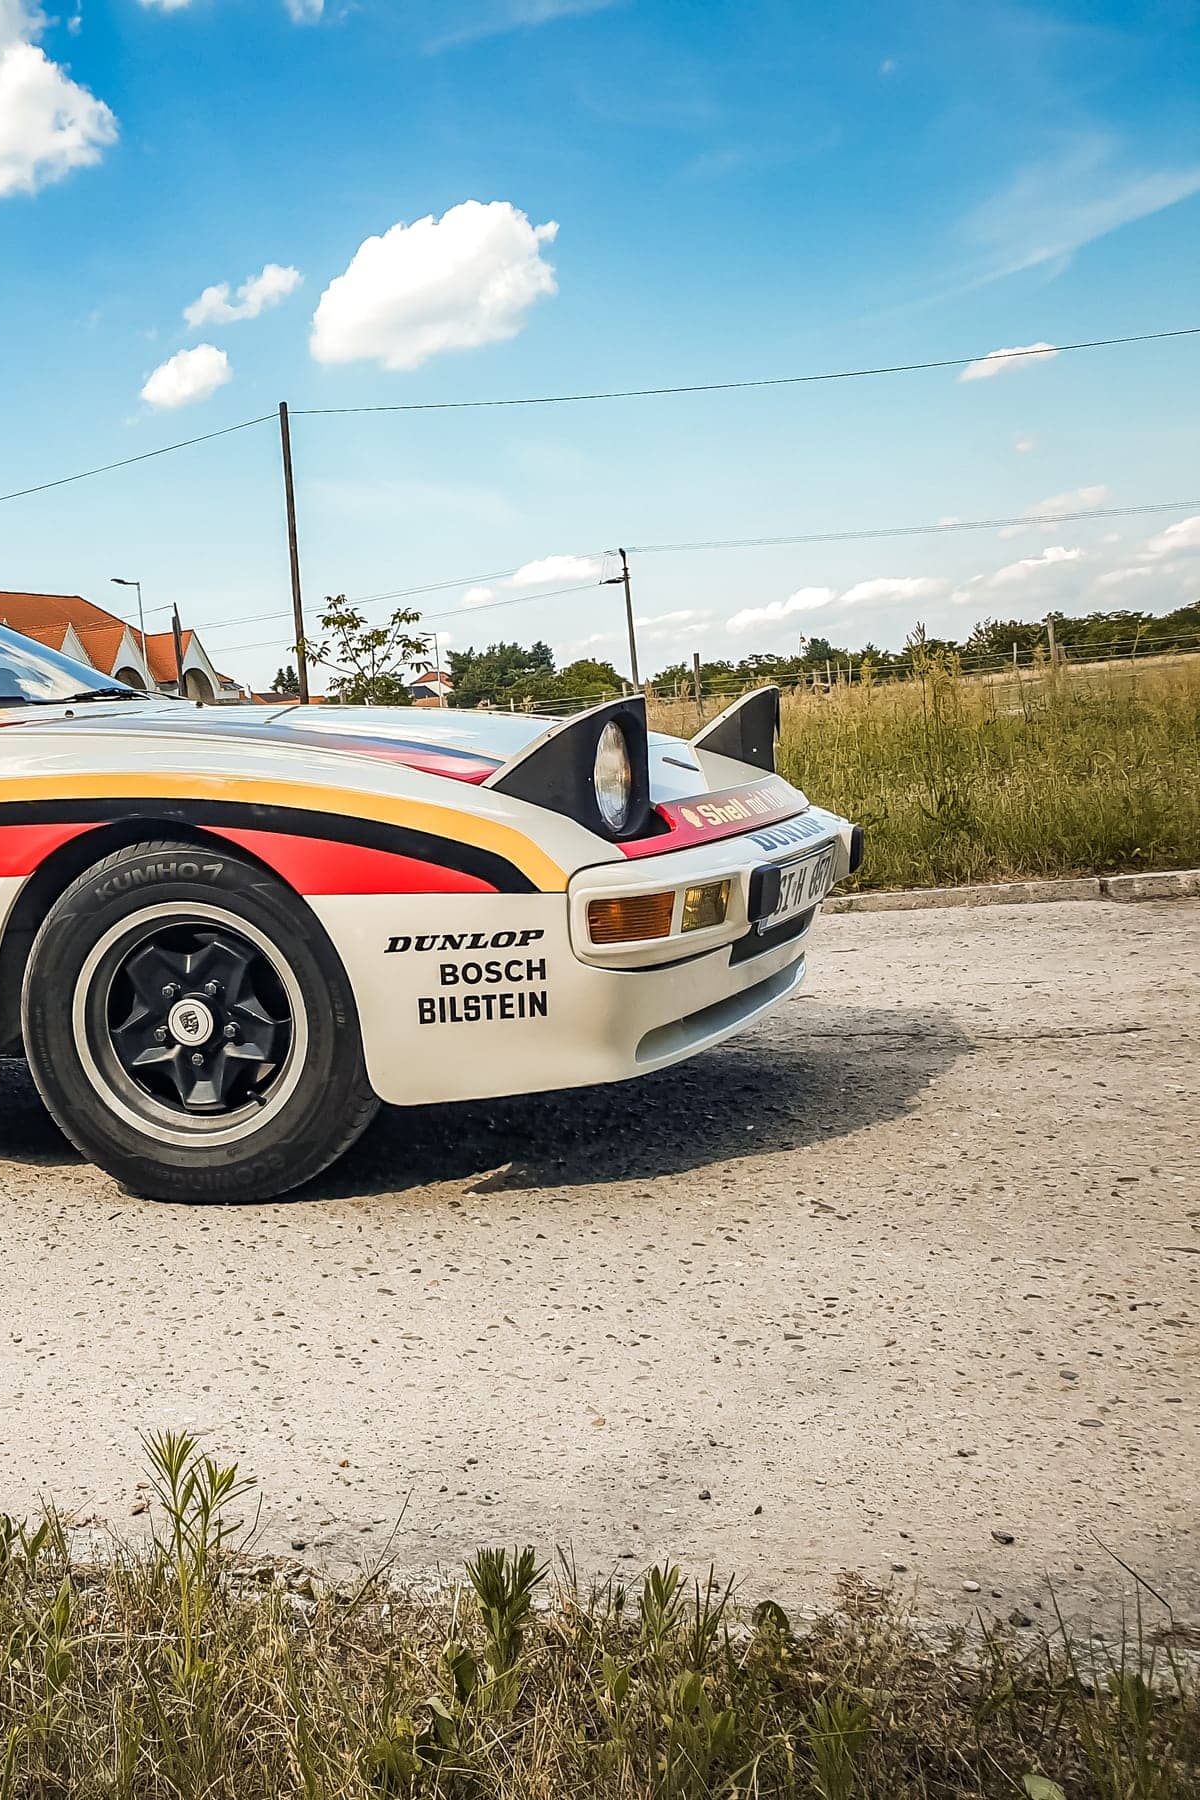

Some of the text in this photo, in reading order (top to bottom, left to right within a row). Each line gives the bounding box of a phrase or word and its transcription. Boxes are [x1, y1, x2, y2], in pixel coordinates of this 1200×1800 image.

[696, 798, 752, 826] Shell
[743, 816, 826, 852] DUNLOP
[94, 861, 200, 900] KUMHO
[383, 929, 545, 953] DUNLOP
[439, 958, 547, 986] BOSCH
[418, 990, 548, 1024] BILSTEIN
